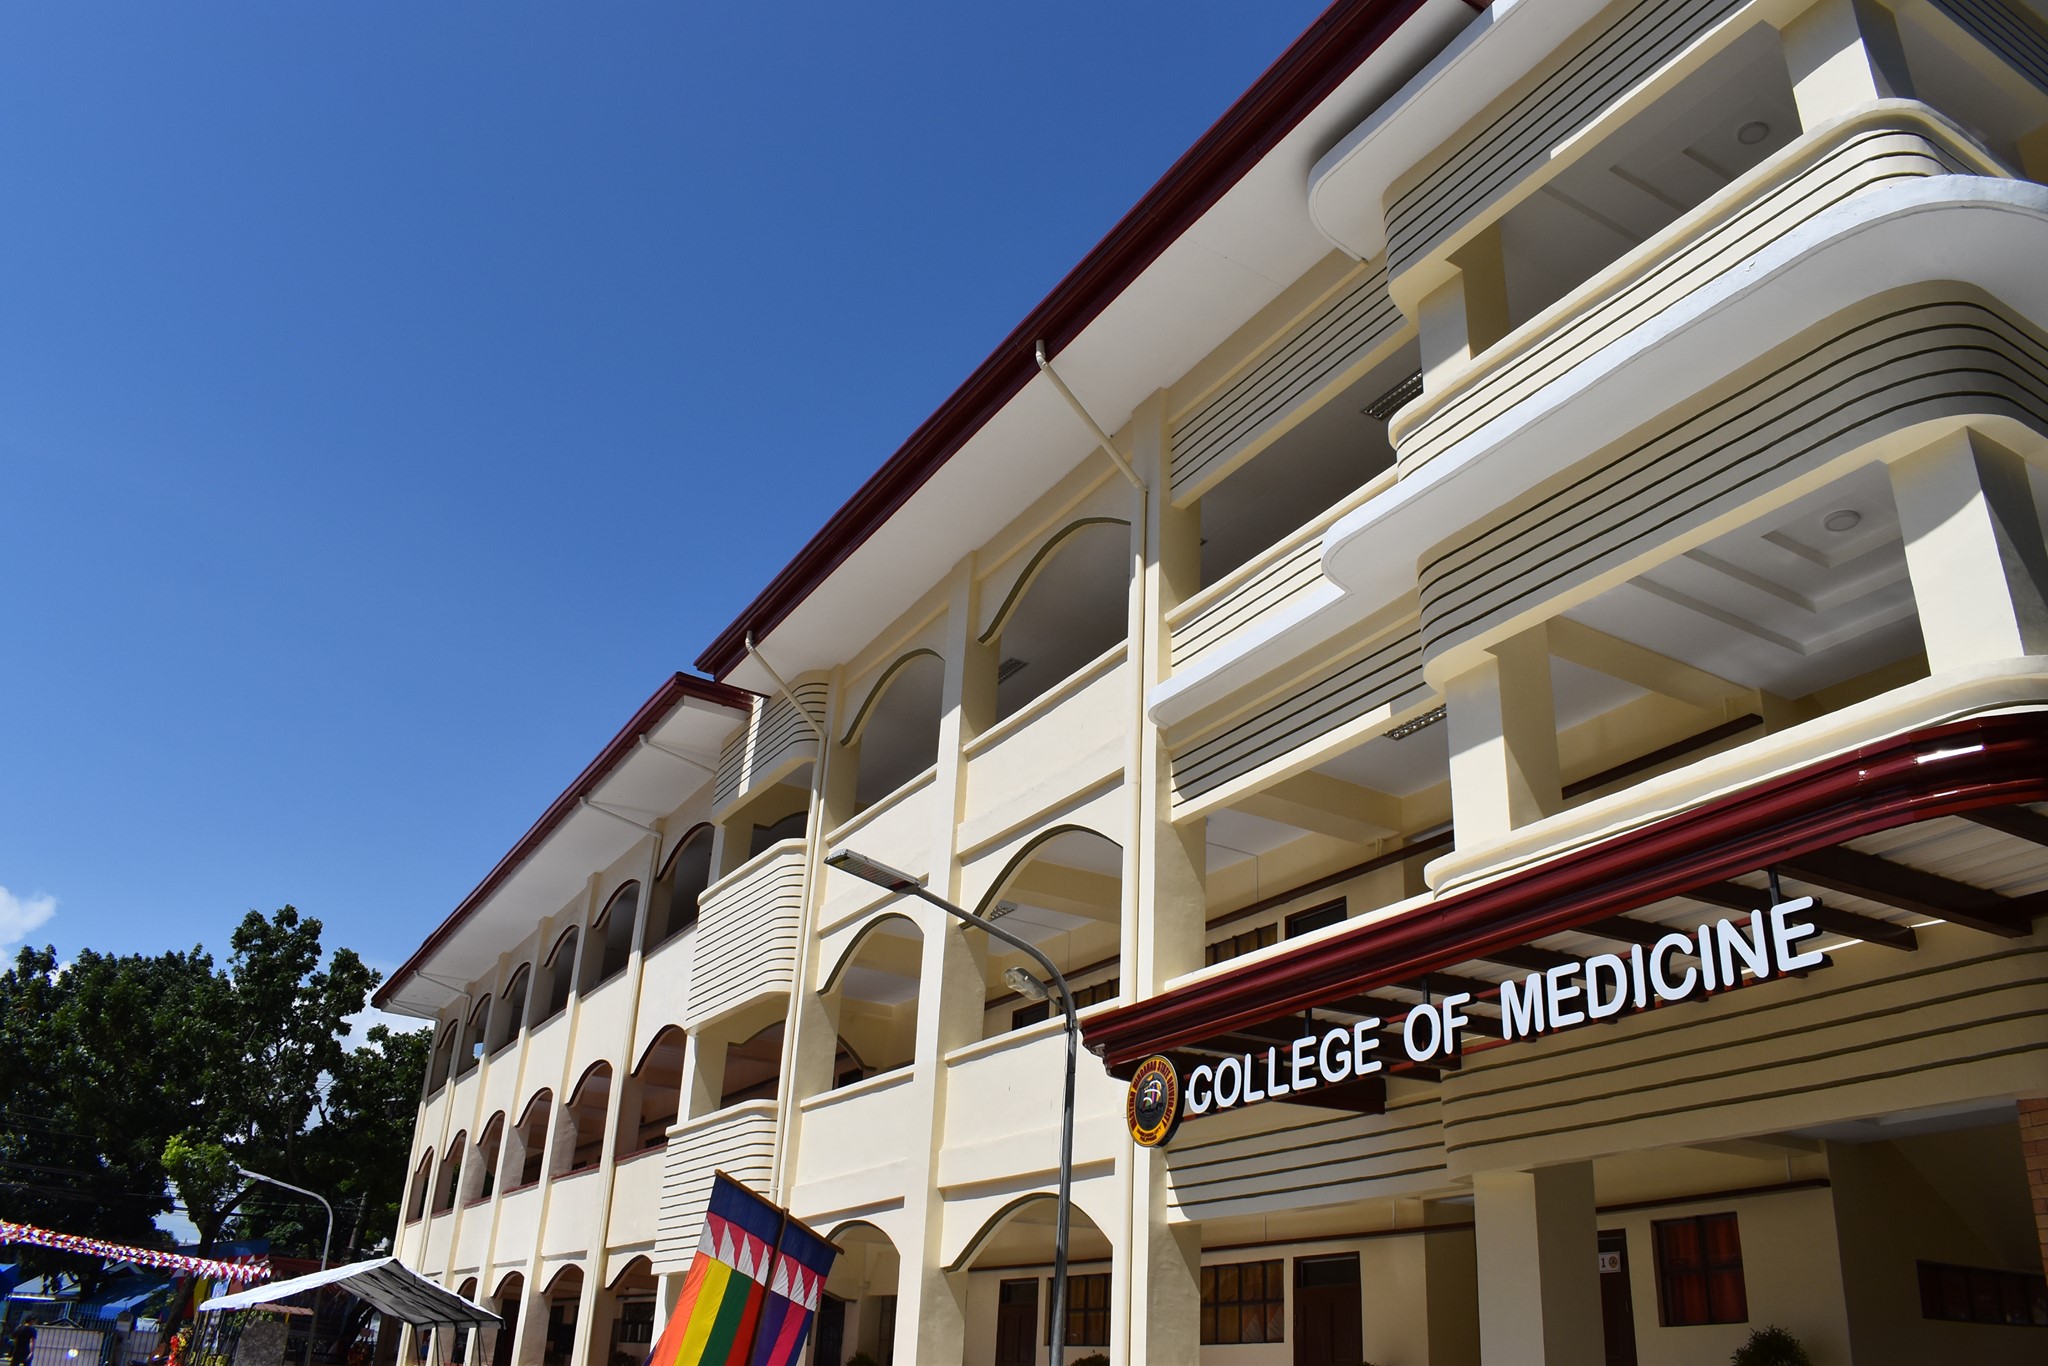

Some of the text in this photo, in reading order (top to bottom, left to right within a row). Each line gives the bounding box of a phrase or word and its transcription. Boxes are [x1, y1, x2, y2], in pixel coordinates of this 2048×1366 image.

[1187, 897, 1824, 1115] COLLEGE OF MEDICINE
[1157, 1061, 1170, 1079] STATE
[1162, 1076, 1174, 1128] UNIVERSITY
